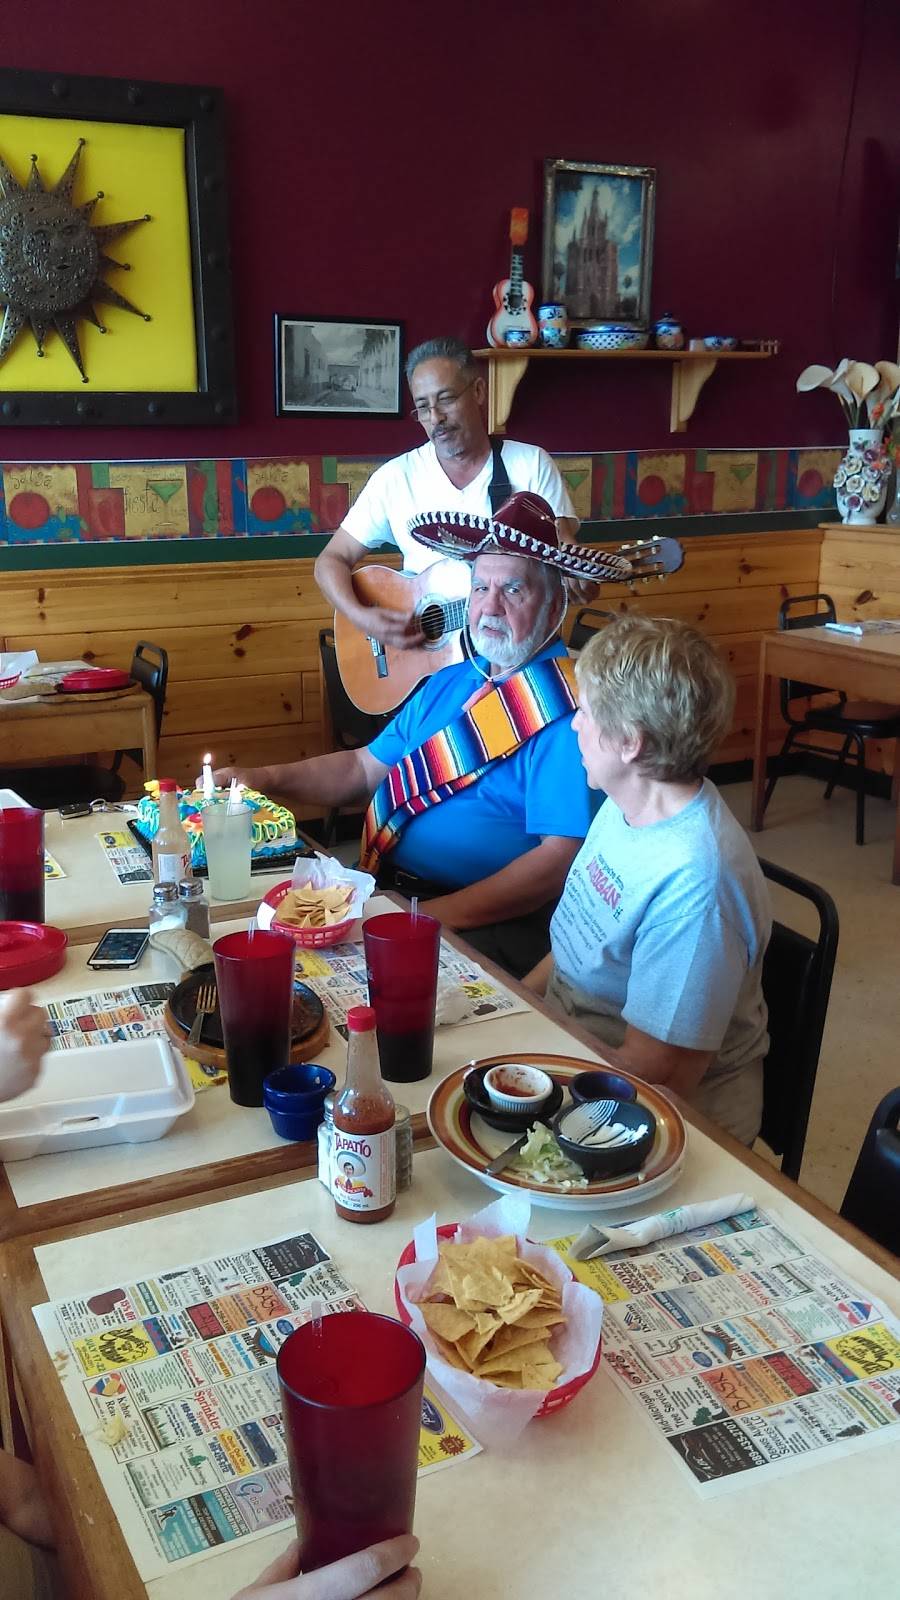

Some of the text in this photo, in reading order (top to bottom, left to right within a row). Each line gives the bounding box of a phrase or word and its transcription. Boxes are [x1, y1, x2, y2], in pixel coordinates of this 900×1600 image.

[607, 1263, 642, 1295] CROWN
[191, 1389, 224, 1432] Sprinkler
[635, 1389, 677, 1434] Mid-Michigan
[649, 1387, 677, 1413] Service
[705, 1370, 753, 1412] BASK
[666, 1411, 689, 1428] Tree
[748, 1414, 792, 1455] SERVICES LLC
[721, 1418, 768, 1466] 989-435-2707
